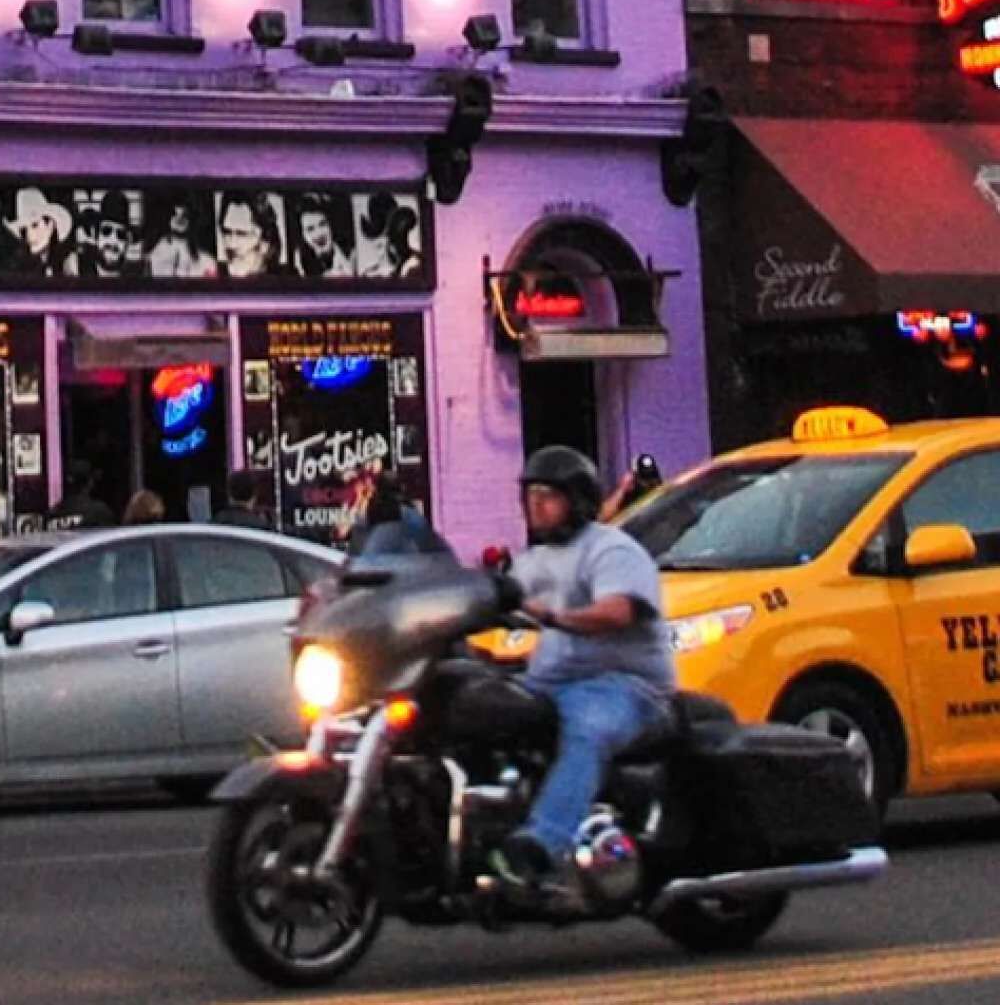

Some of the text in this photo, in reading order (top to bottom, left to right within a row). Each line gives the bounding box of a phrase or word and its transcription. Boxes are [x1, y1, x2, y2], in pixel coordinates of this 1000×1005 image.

[754, 245, 842, 280] Second
[757, 276, 845, 314] Fiddle
[281, 429, 389, 484] Tootsies
[941, 615, 1000, 651] YEL
